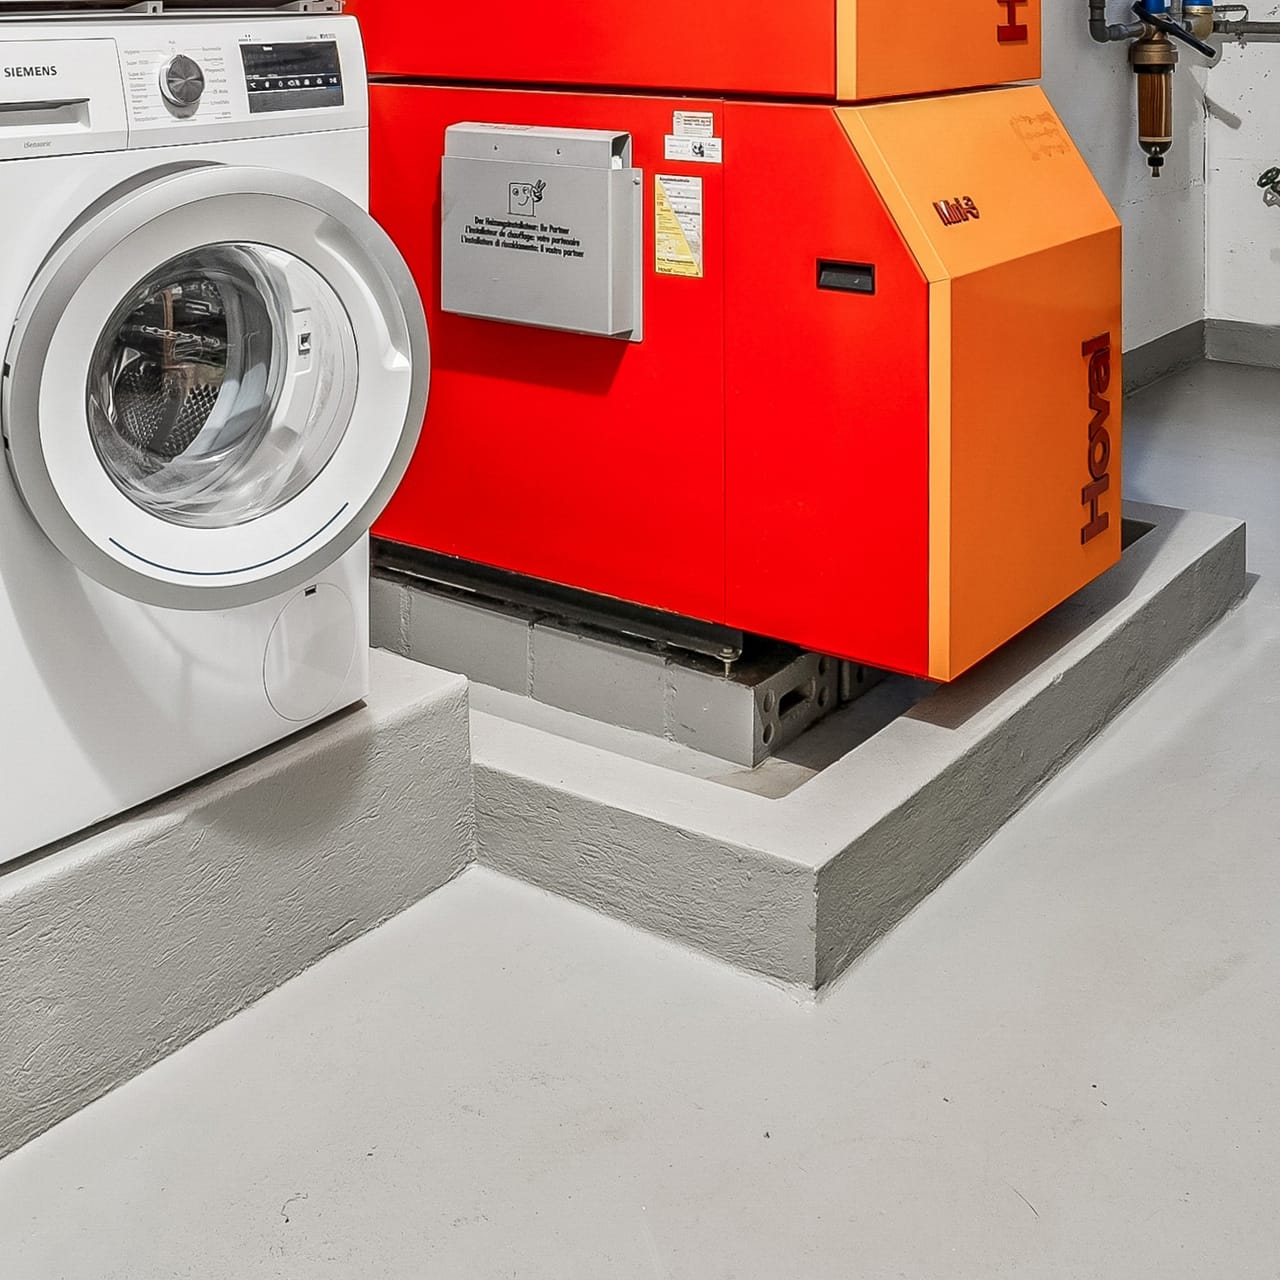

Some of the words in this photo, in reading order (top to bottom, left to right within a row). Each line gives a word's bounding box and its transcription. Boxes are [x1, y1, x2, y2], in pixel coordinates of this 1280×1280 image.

[3, 65, 58, 78] SIEMENS
[474, 216, 484, 225] Der
[549, 224, 570, 235] Partner
[499, 227, 506, 237] de
[537, 234, 550, 243] votre
[551, 236, 580, 247] partenaire
[545, 246, 562, 255] vostro
[563, 249, 584, 258] partner
[1081, 331, 1111, 546] Hoval
